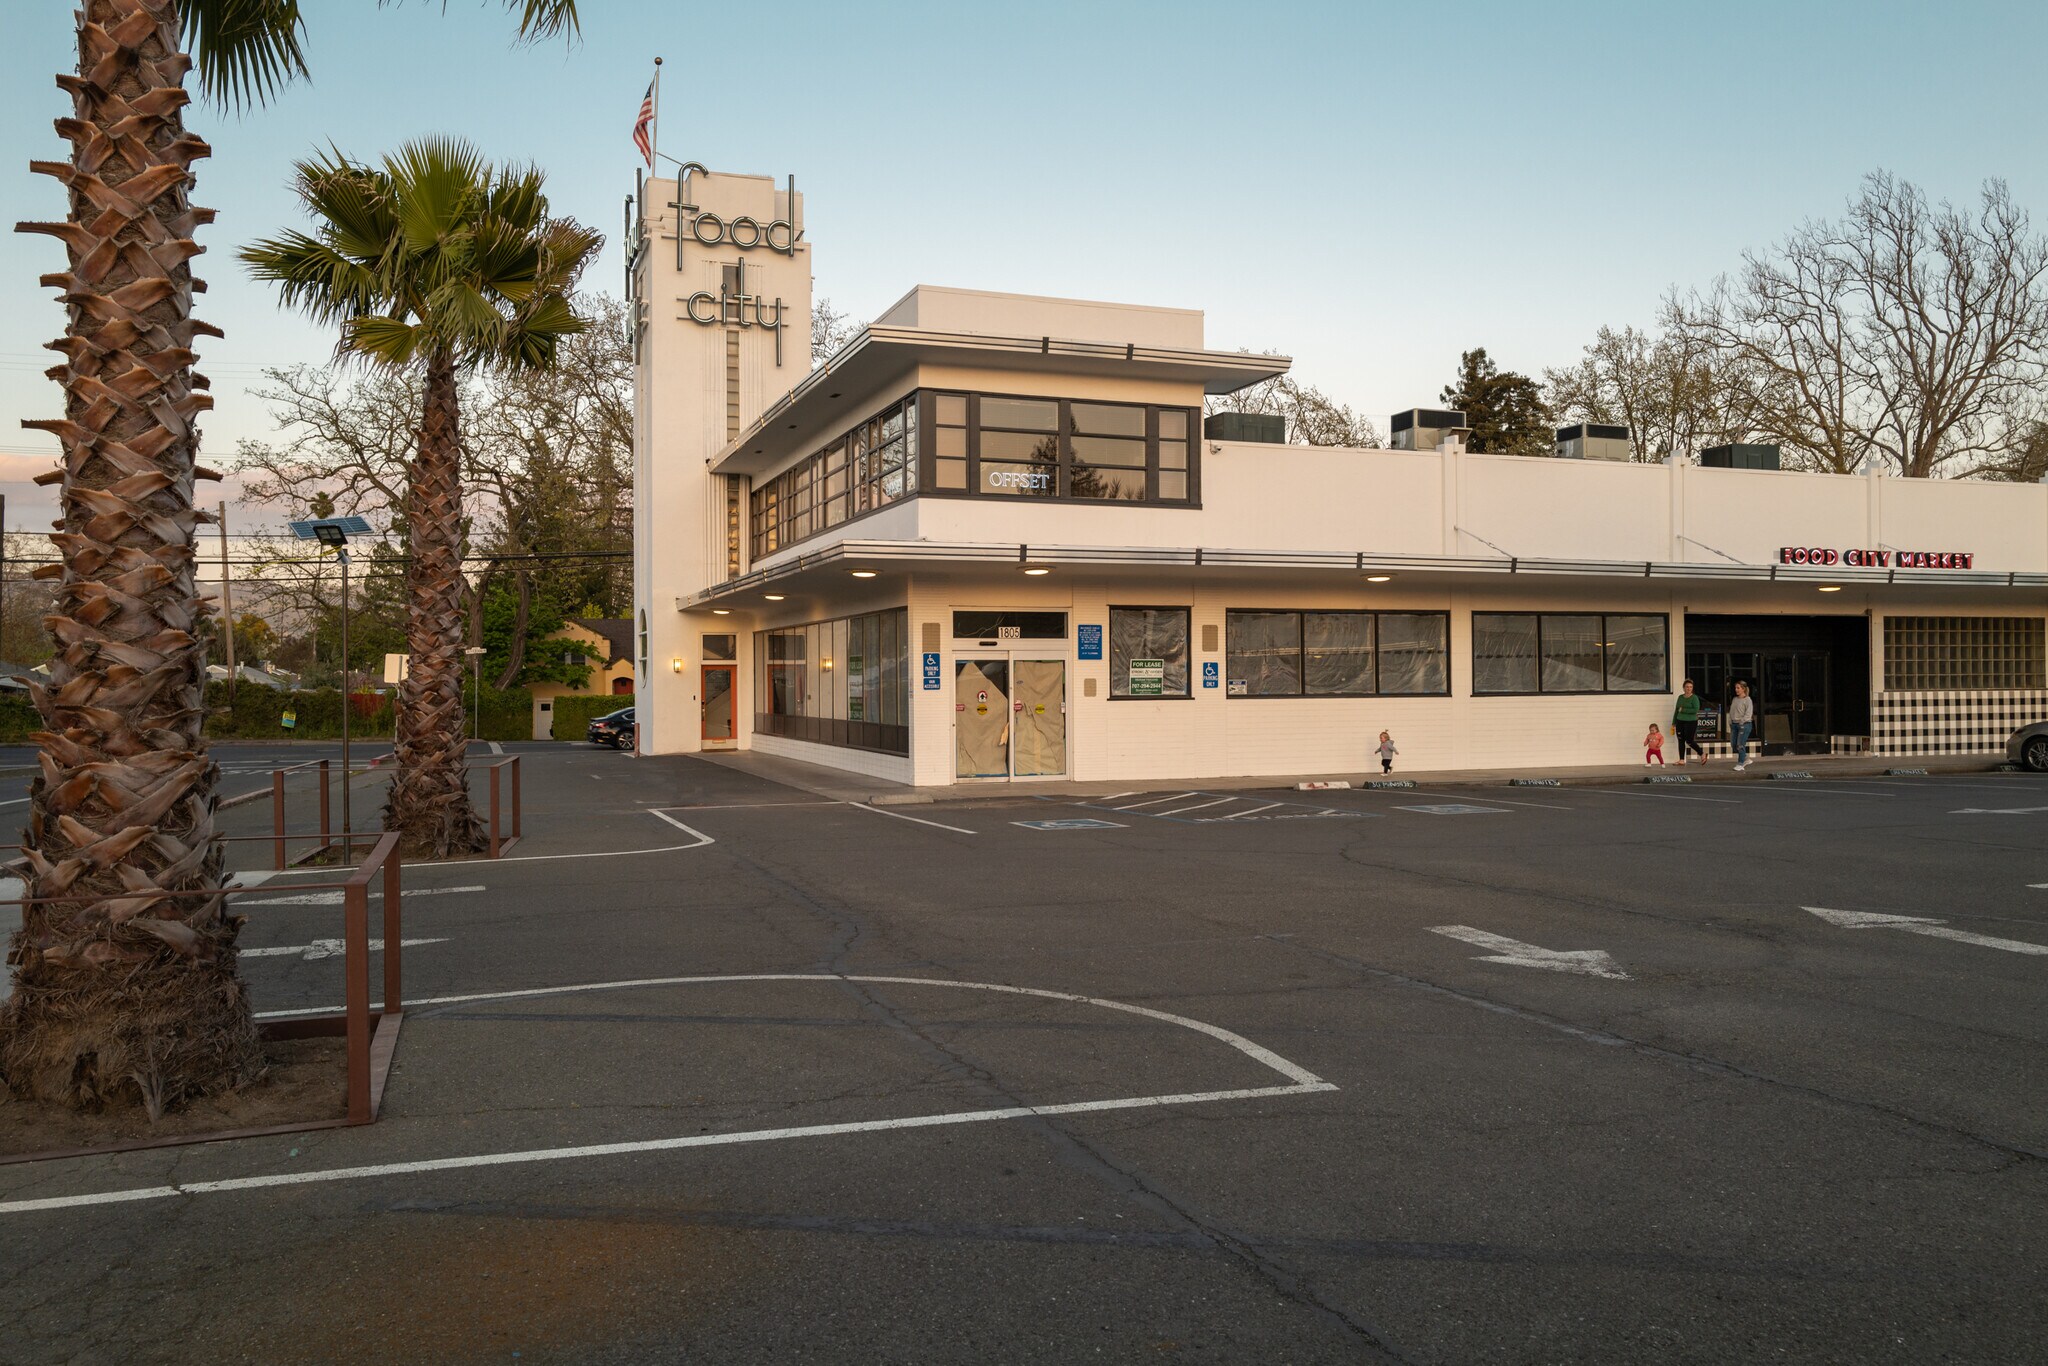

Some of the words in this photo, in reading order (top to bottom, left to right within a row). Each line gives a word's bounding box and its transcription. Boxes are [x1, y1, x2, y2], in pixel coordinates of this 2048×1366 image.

[668, 161, 795, 271] food
[687, 257, 781, 367] city
[989, 471, 1050, 489] OFFSET
[1780, 547, 1839, 566] FOOD
[1843, 549, 1892, 567] CITY
[1896, 551, 1974, 570] MARKET
[1000, 627, 1020, 638] 1805
